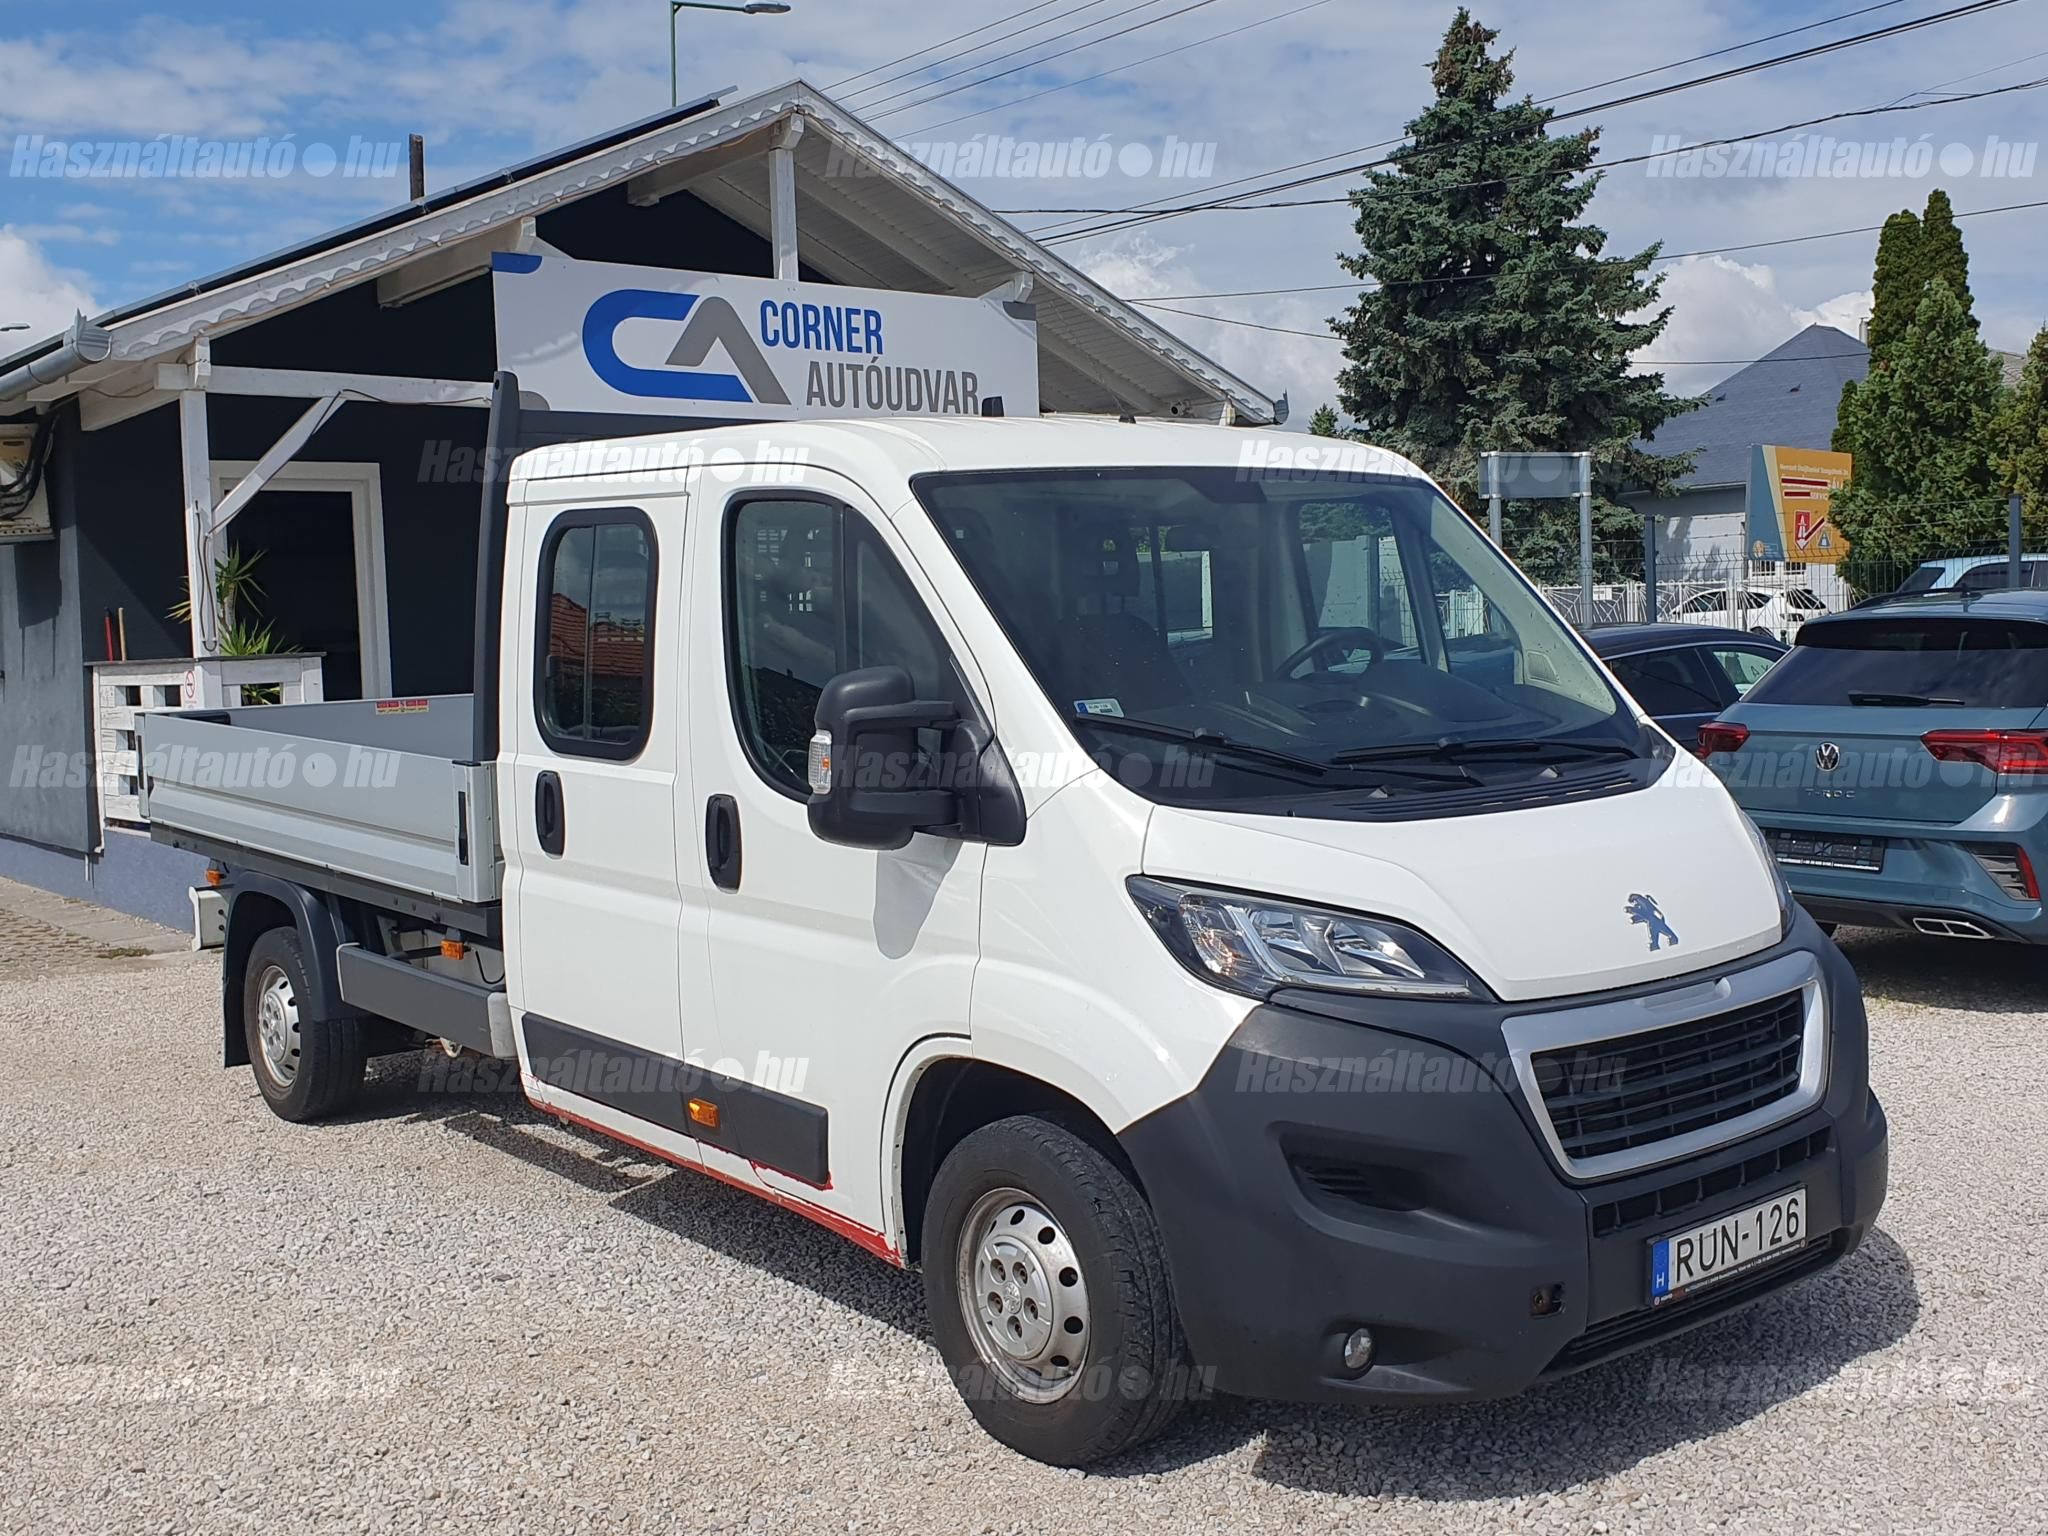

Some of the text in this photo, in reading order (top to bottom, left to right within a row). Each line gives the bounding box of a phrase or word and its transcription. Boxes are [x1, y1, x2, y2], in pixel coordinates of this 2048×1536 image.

[760, 299, 884, 355] CORNER
[806, 356, 980, 416] AUTÓUDVAR
[1675, 1196, 1800, 1284] RUN-126
[1655, 1271, 1666, 1289] H
